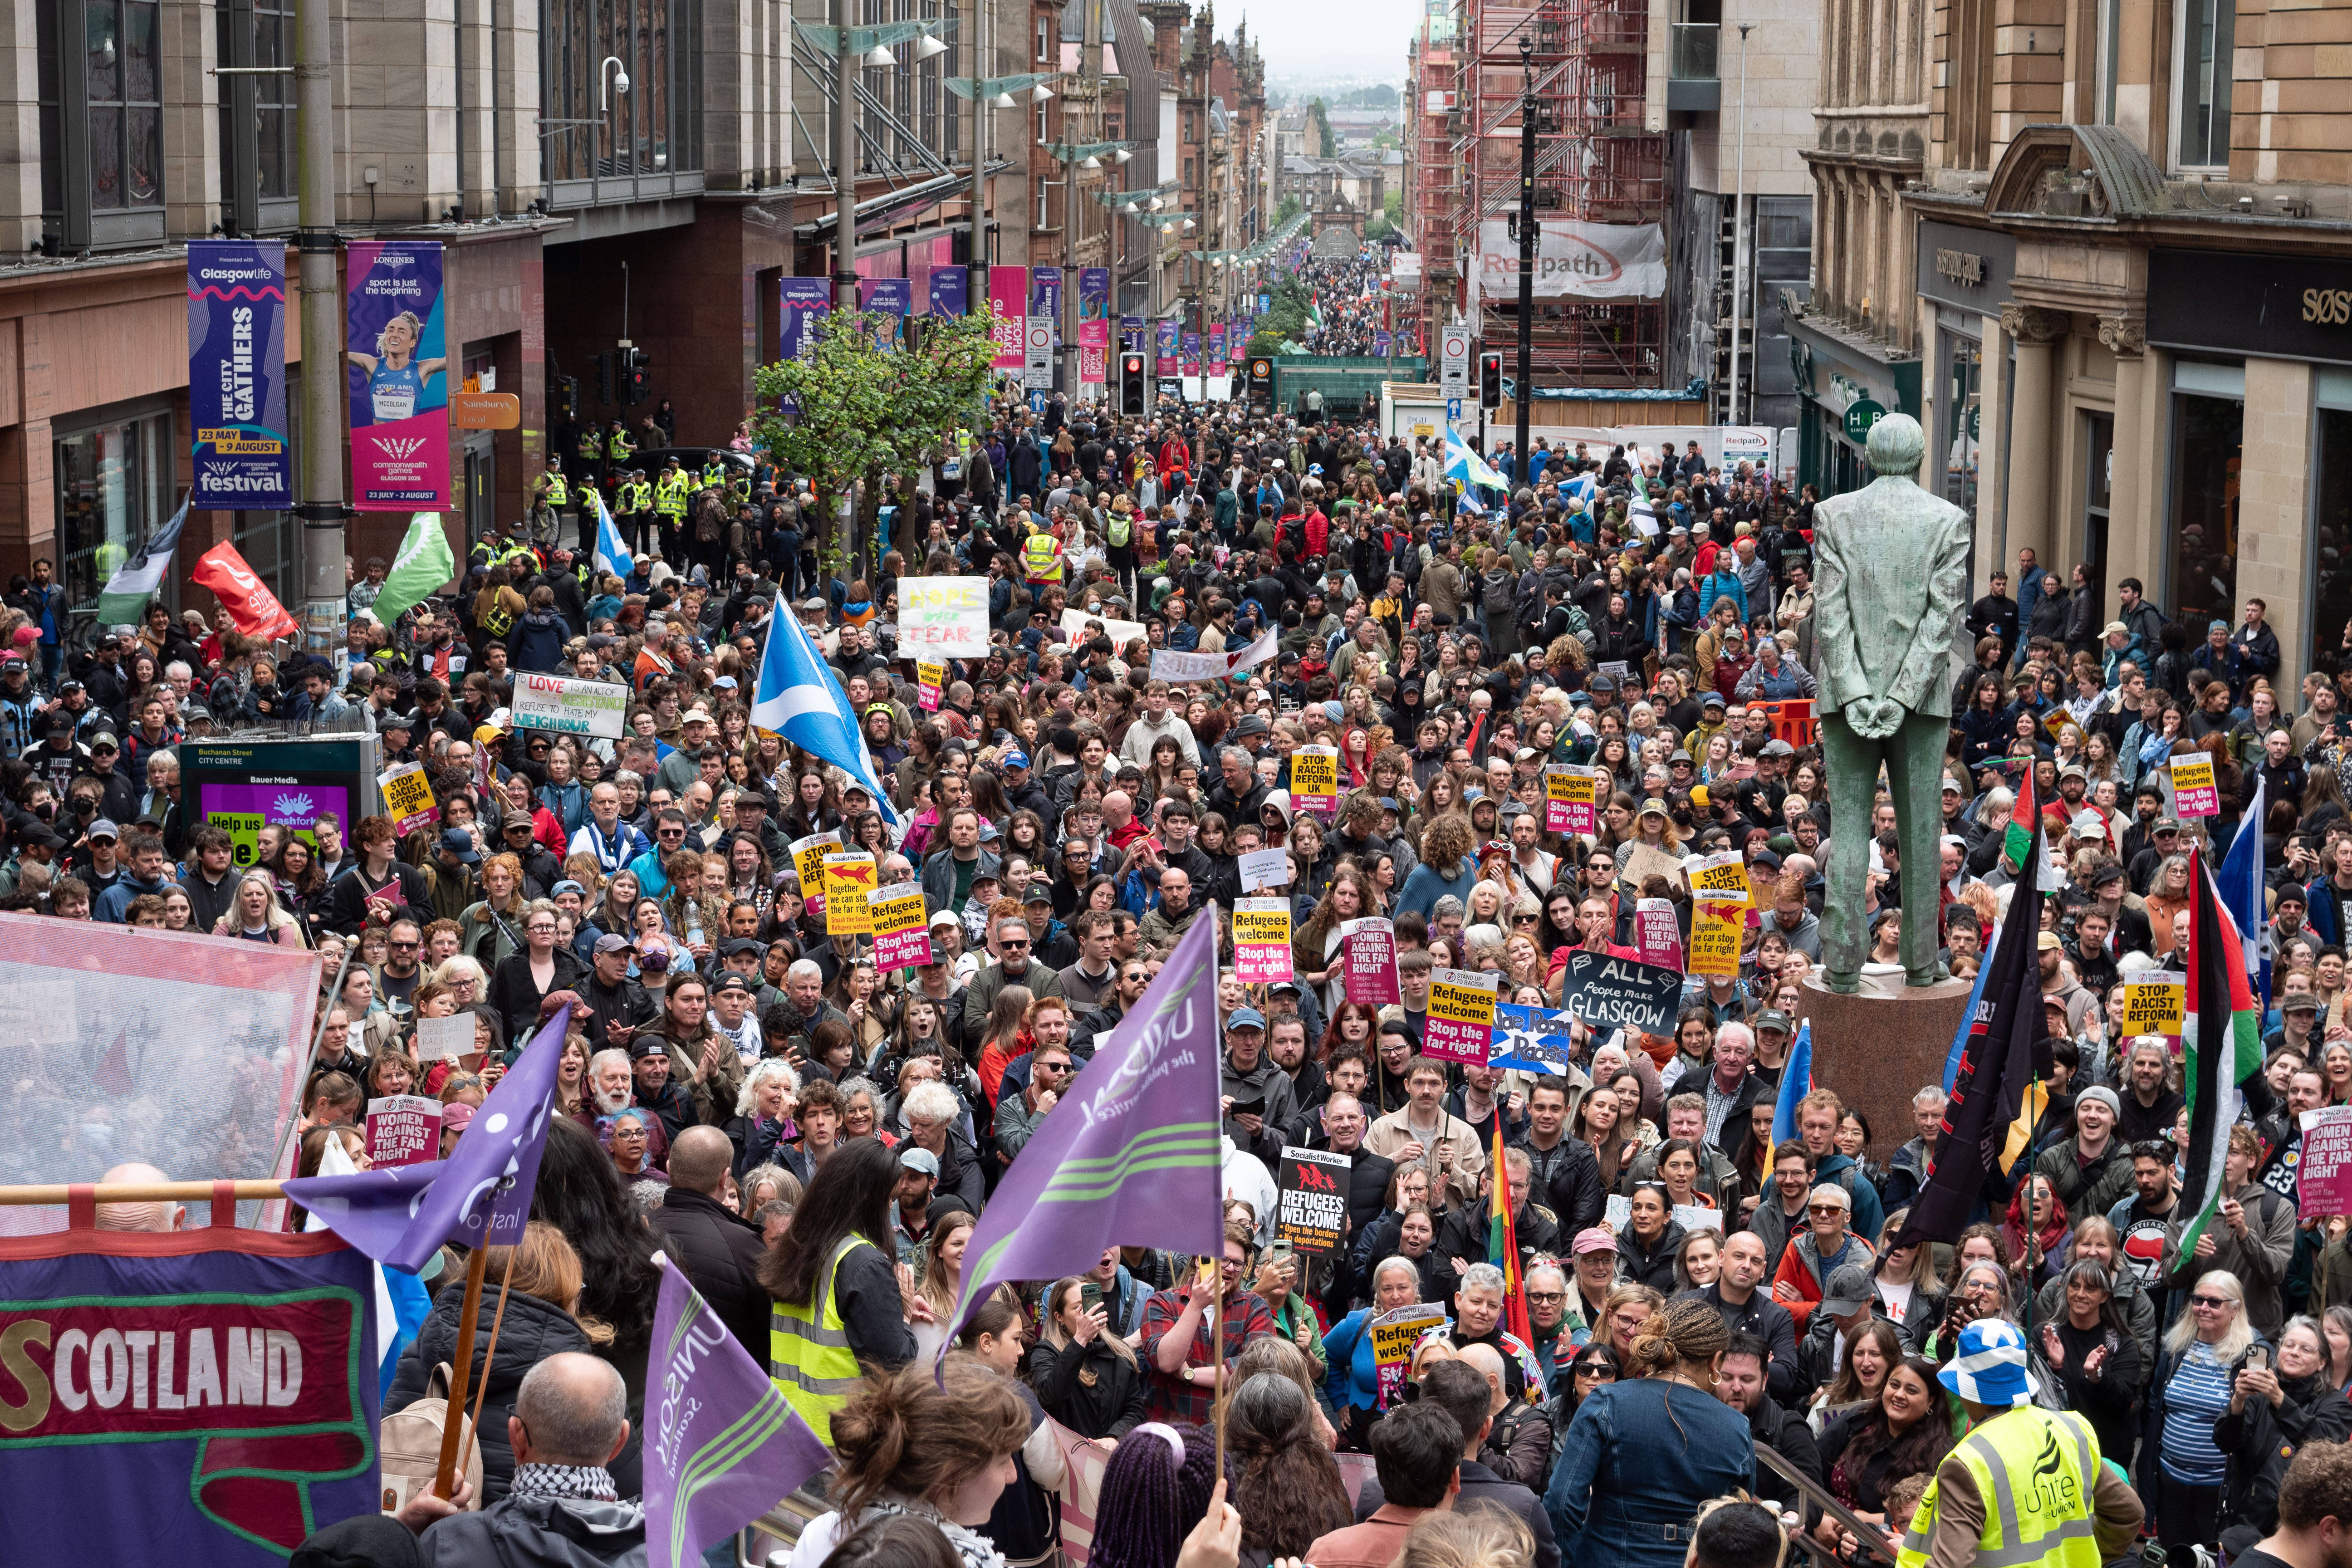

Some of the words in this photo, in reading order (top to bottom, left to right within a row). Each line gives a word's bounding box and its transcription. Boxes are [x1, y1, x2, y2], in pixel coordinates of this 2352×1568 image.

[201, 268, 271, 283] Glasgowlife
[369, 279, 390, 288] sport
[402, 279, 416, 288] just
[381, 287, 421, 295] beginning
[1004, 324, 1012, 355] MAKE
[1013, 316, 1022, 355] PEOPLE
[233, 307, 254, 420] GATHERS
[221, 360, 232, 392] CITY
[223, 394, 234, 420] THE
[463, 400, 510, 409] Sainsbury's
[201, 431, 213, 439] 23
[216, 431, 237, 439] MAY
[1726, 437, 1760, 446] Redpath
[226, 442, 232, 451] 9
[234, 442, 277, 451] AUGUST
[201, 472, 284, 491] festival
[910, 589, 978, 608] HOPE
[924, 612, 960, 622] OVER
[911, 626, 972, 643] FEAR
[517, 674, 526, 683] TO
[529, 676, 565, 693] LOVE
[571, 682, 580, 691] IS
[561, 693, 627, 710] RESISTANCE
[519, 701, 547, 712] REFUSE
[549, 705, 559, 713] TO
[564, 707, 583, 717] HATE
[585, 710, 598, 719] MY
[514, 713, 590, 733] NEIGHBOUR
[1303, 756, 1326, 764] STOP
[1298, 765, 1330, 774] RACIST
[2174, 767, 2210, 777] Refugees
[390, 775, 414, 790] STOP
[1295, 775, 1333, 784] REFORM
[2176, 777, 2210, 787] welcome
[390, 782, 421, 801] RACIST
[1308, 784, 1321, 793] UK
[2176, 792, 2195, 802] Stop
[2197, 789, 2211, 799] the
[392, 789, 428, 811] REFORM
[2178, 802, 2190, 811] far
[2192, 799, 2213, 811] right
[405, 803, 419, 813] UK
[212, 817, 242, 833] Help
[245, 820, 260, 830] us
[402, 811, 429, 825] Refugees
[405, 818, 430, 831] welcome
[872, 900, 921, 918] Refugees
[874, 914, 921, 931] welcome
[877, 936, 901, 950] Stop
[1351, 933, 1386, 944] WOMEN
[878, 951, 896, 964] far
[897, 945, 924, 960] right
[1351, 942, 1390, 954] AGAINST
[1351, 952, 1371, 964] THE
[1373, 953, 1389, 965] FAR
[1352, 963, 1382, 974] RIGHT
[1599, 960, 1652, 985] ALL
[1464, 980, 1484, 988] RACISM
[1583, 981, 1621, 998] People
[1624, 989, 1654, 1000] make
[2138, 985, 2170, 997] STOP
[1433, 985, 1493, 1006] Refugees
[2132, 997, 2176, 1009] RACIST
[1431, 1002, 1488, 1020] welcome
[1568, 993, 1666, 1027] GLASGOW
[2128, 1009, 2177, 1022] REFORM
[1428, 1019, 1458, 1039] Stop
[1461, 1026, 1483, 1040] the
[1529, 1009, 1571, 1038] Room
[2144, 1021, 2160, 1033] UK
[1426, 1035, 1446, 1049] far
[1449, 1039, 1481, 1056] right
[1511, 1035, 1567, 1064] Racists
[377, 1113, 423, 1126] WOMEN
[375, 1124, 431, 1139] AGAINST
[374, 1137, 397, 1150] THE
[401, 1136, 425, 1150] FAR
[373, 1148, 412, 1161] RIGHT
[2263, 1163, 2297, 1194] 23
[1282, 1189, 1344, 1213] REFUGEES
[1281, 1205, 1342, 1230] WELCOME
[1285, 1224, 1300, 1233] Open
[1302, 1225, 1313, 1235] the
[1314, 1228, 1338, 1239] borders
[1294, 1235, 1334, 1248] deportations
[0, 1319, 302, 1431] SCOTLAND
